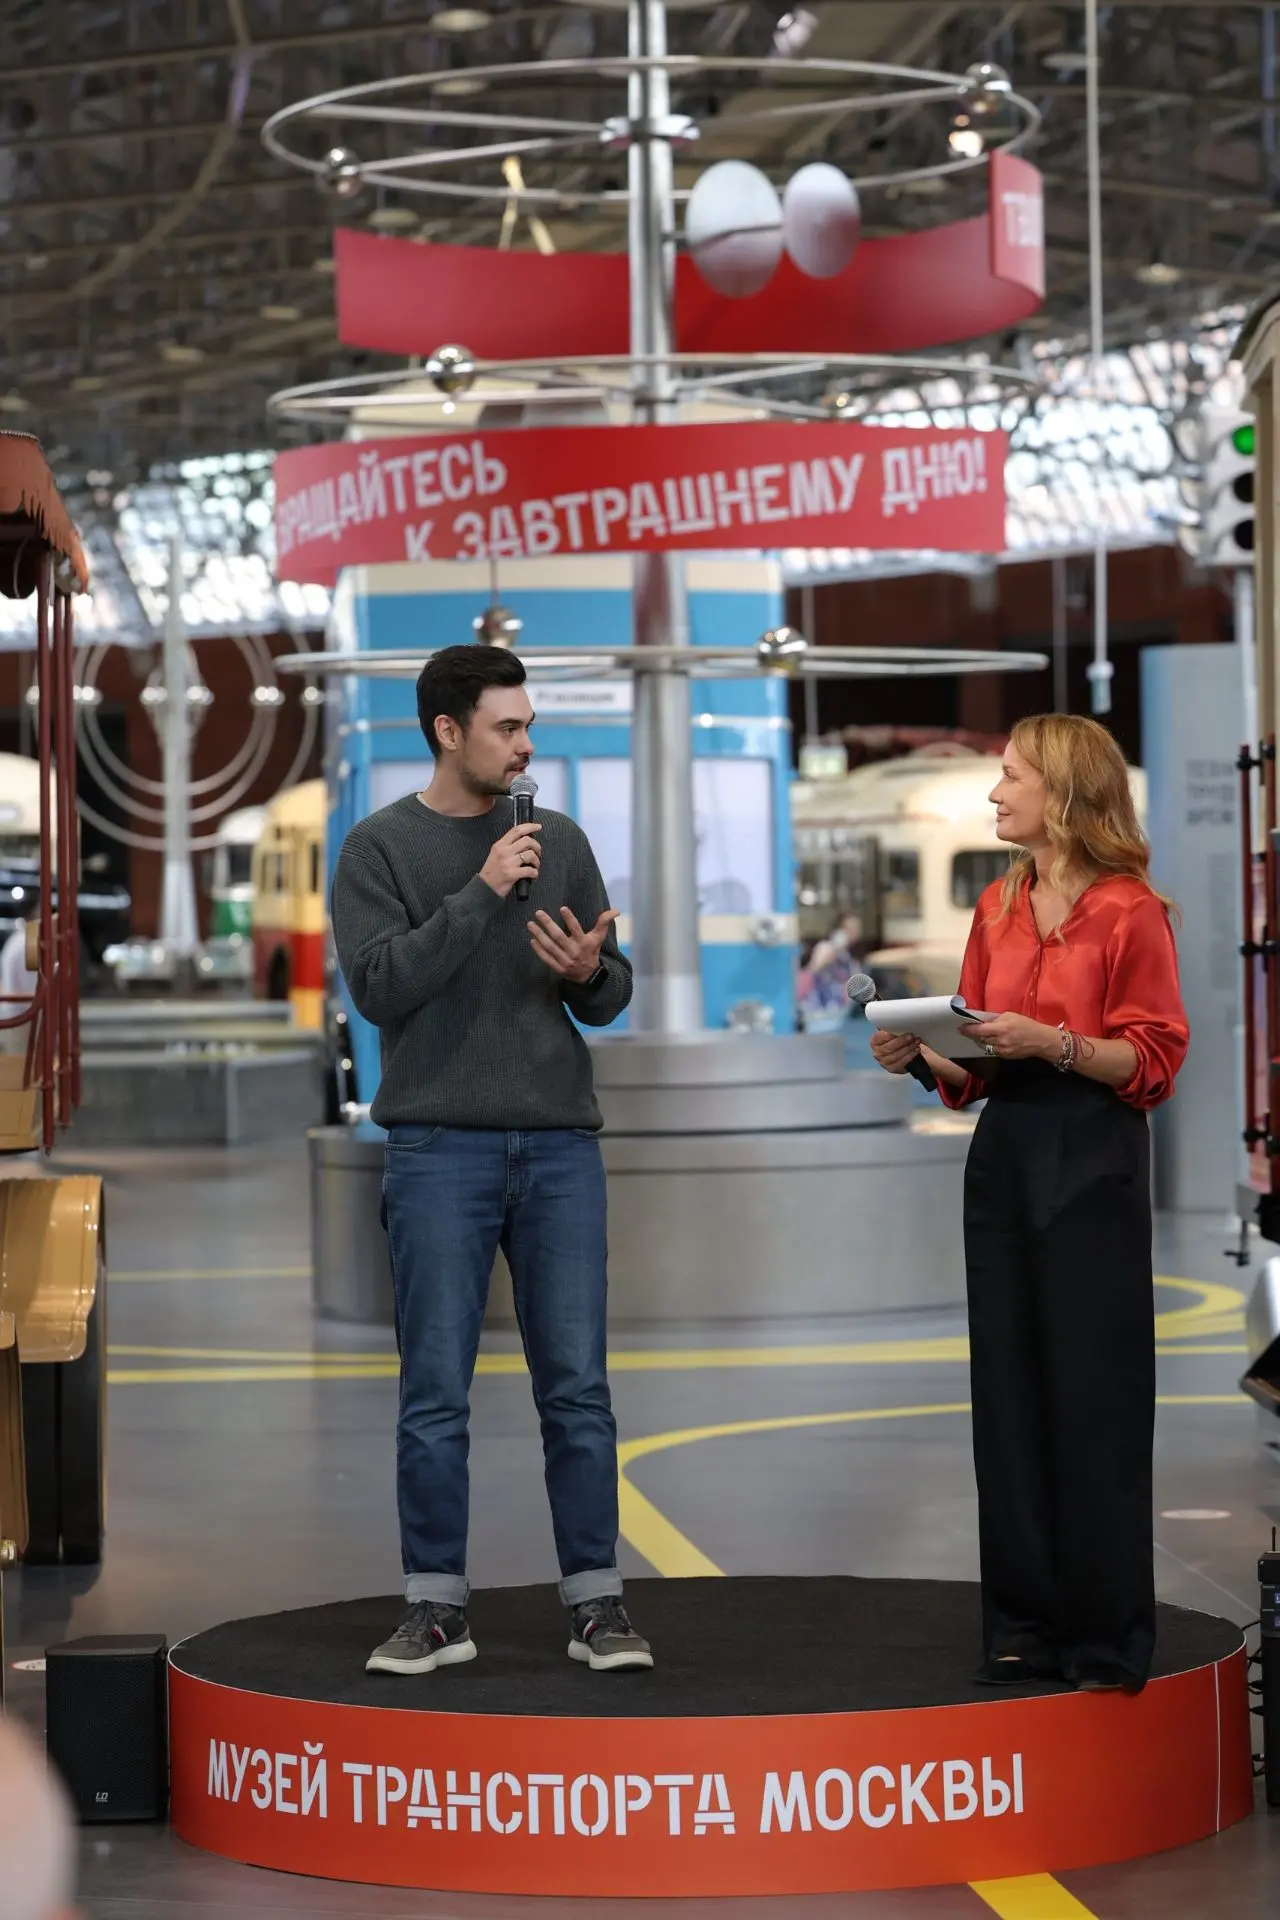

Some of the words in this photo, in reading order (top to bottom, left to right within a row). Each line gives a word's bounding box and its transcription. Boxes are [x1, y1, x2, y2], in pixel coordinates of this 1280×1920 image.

[404, 520, 433, 562] К
[453, 453, 864, 561] ЗАВТРАШНЕМУ
[881, 437, 988, 517] ДНЮ!
[208, 1740, 328, 1818] МУЗЕЙ
[342, 1762, 736, 1837] ТРАНСПОРТА
[758, 1752, 1023, 1834] МОСКВЫ
